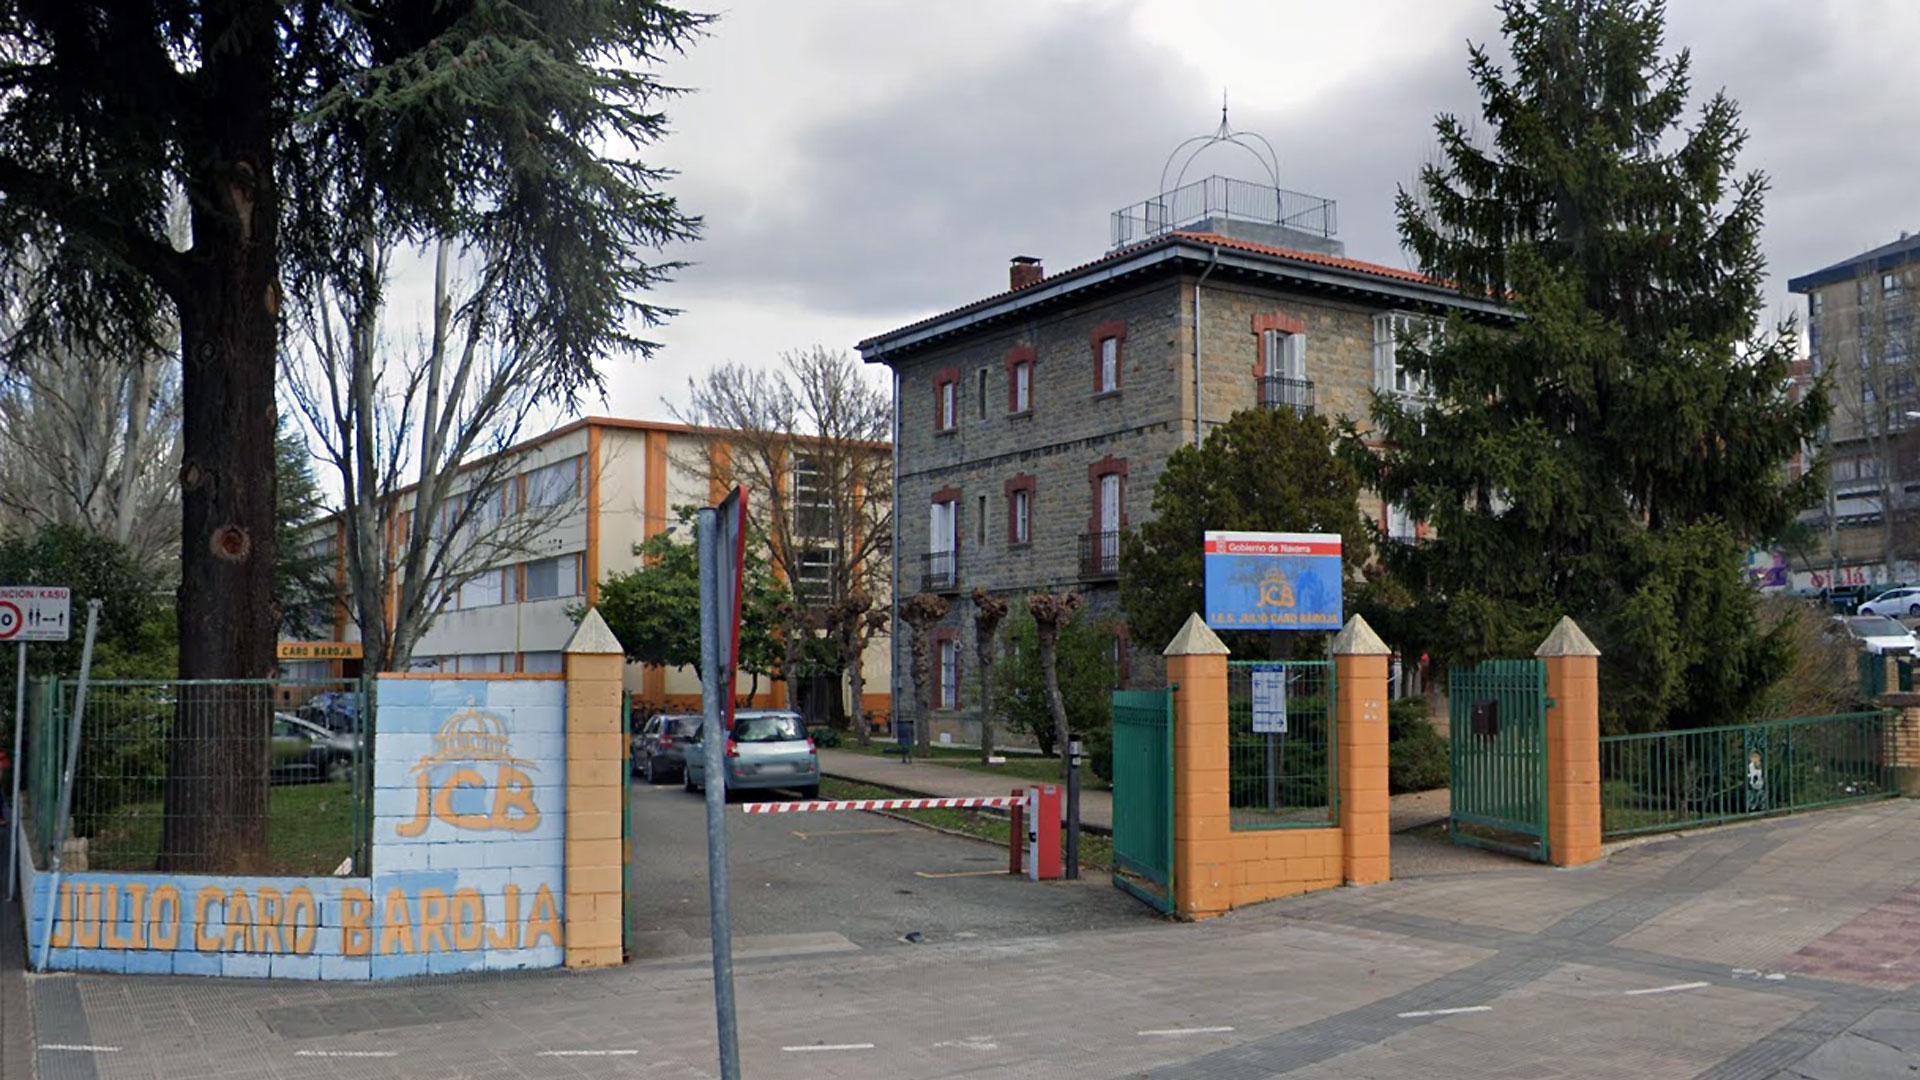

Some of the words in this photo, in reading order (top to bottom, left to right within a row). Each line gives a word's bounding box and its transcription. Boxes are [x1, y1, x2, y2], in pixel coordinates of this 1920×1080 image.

[1228, 542, 1267, 552] Gobierno
[1268, 544, 1279, 553] de
[282, 646, 309, 656] CARO
[313, 646, 353, 657] BAROJA
[395, 765, 542, 838] JCB
[50, 881, 181, 950] JULIO
[194, 885, 319, 955] CARO
[340, 883, 564, 957] BAROJA
